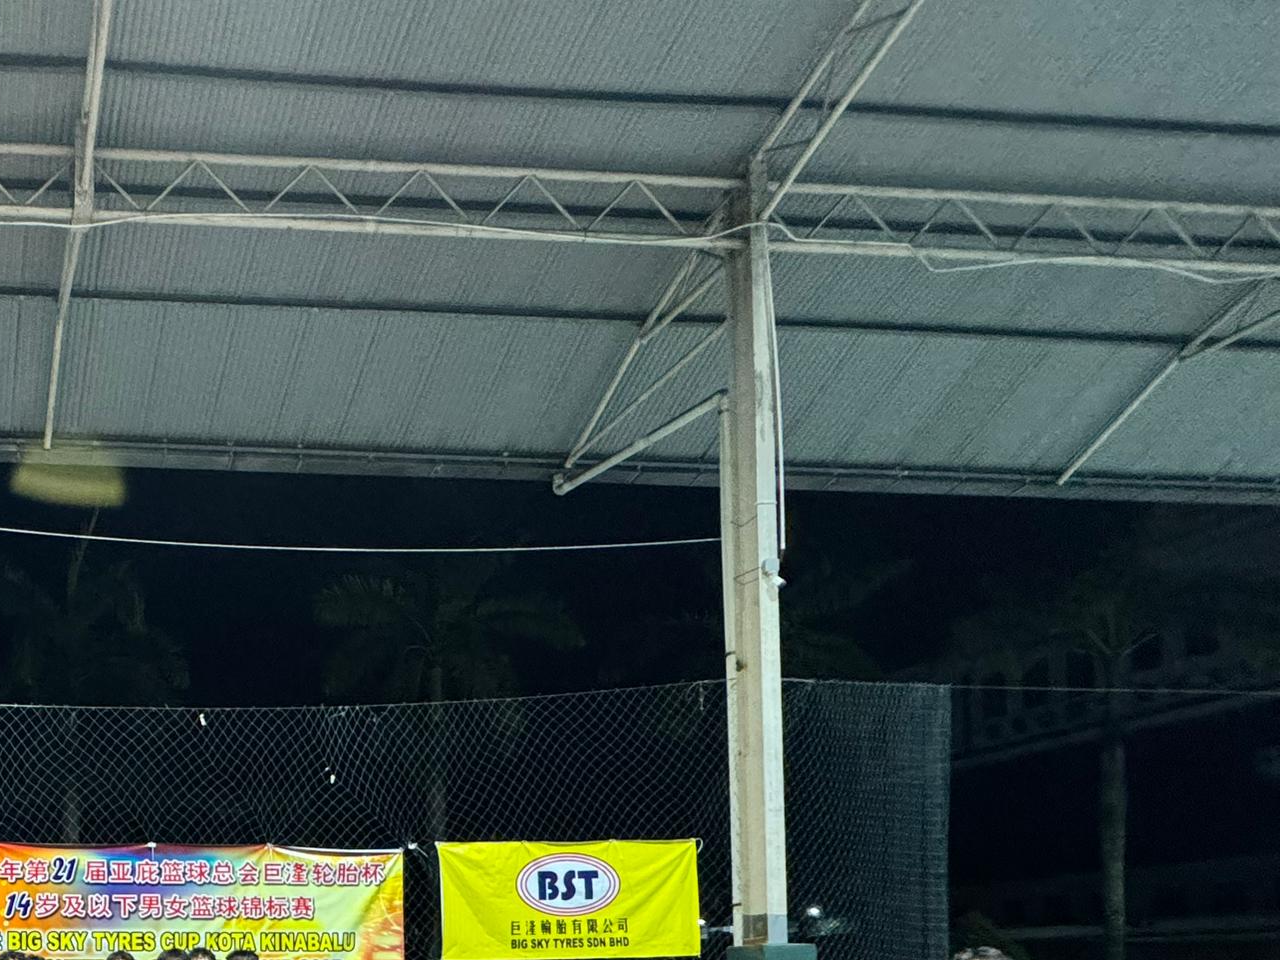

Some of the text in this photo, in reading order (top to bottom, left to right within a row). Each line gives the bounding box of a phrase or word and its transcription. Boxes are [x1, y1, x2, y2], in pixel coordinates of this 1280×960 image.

[538, 870, 598, 901] BST
[7, 930, 43, 951] BIG
[47, 931, 88, 951] SKY
[93, 931, 156, 951] TYRES
[160, 932, 200, 951] CUP
[205, 932, 256, 951] KOTA
[261, 932, 356, 951] KINABALU
[511, 936, 629, 949] BIG SKY TYRES SDN BHD
